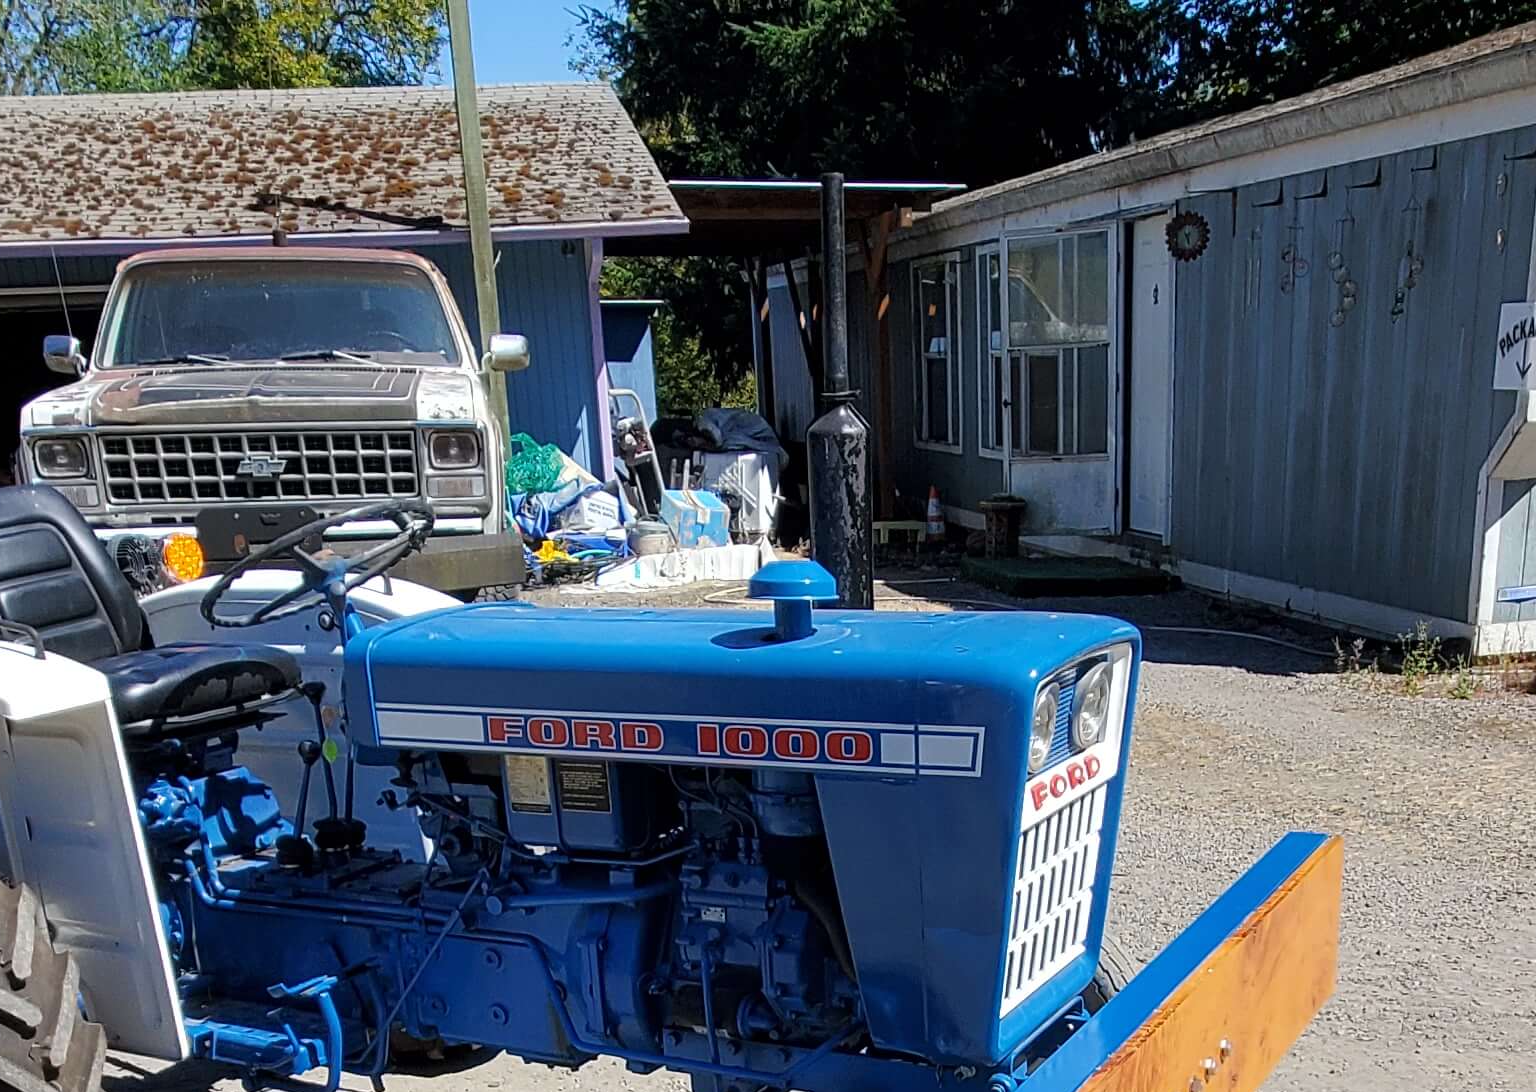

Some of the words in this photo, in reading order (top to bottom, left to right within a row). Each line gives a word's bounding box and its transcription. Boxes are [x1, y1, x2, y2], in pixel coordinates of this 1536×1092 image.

[487, 716, 664, 752] FORD
[696, 723, 874, 763] 1000
[1030, 754, 1101, 811] FORD
